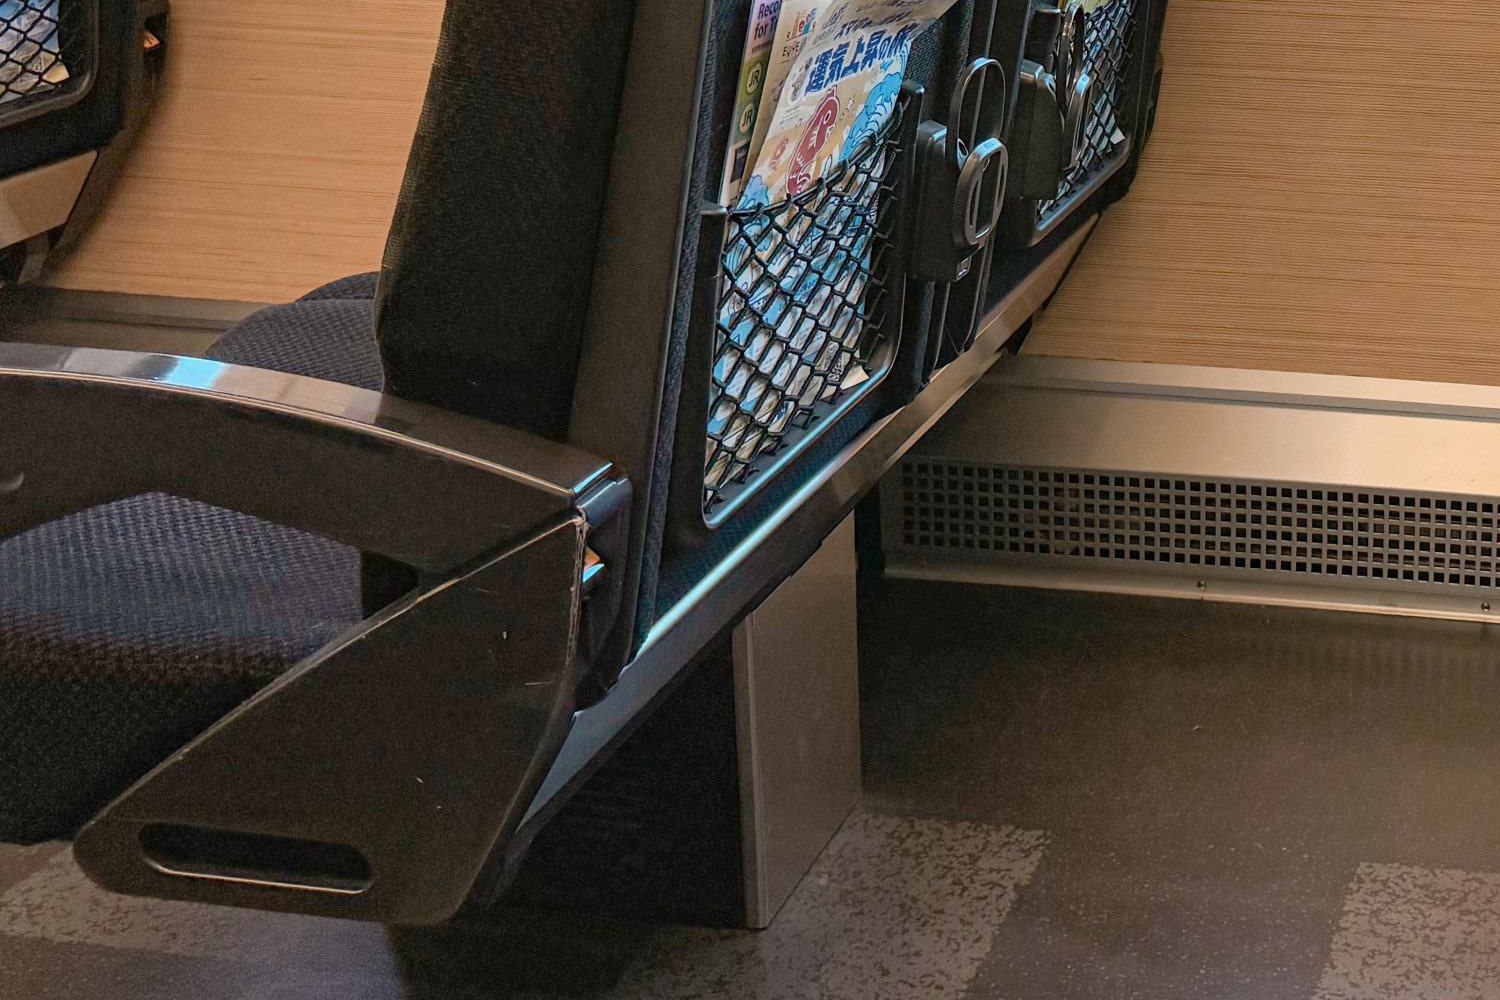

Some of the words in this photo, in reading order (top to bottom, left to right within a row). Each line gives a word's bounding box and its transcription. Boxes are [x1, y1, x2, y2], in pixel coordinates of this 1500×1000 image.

[754, 23, 770, 41] for
[748, 69, 761, 88] JR
[742, 110, 753, 129] JR
